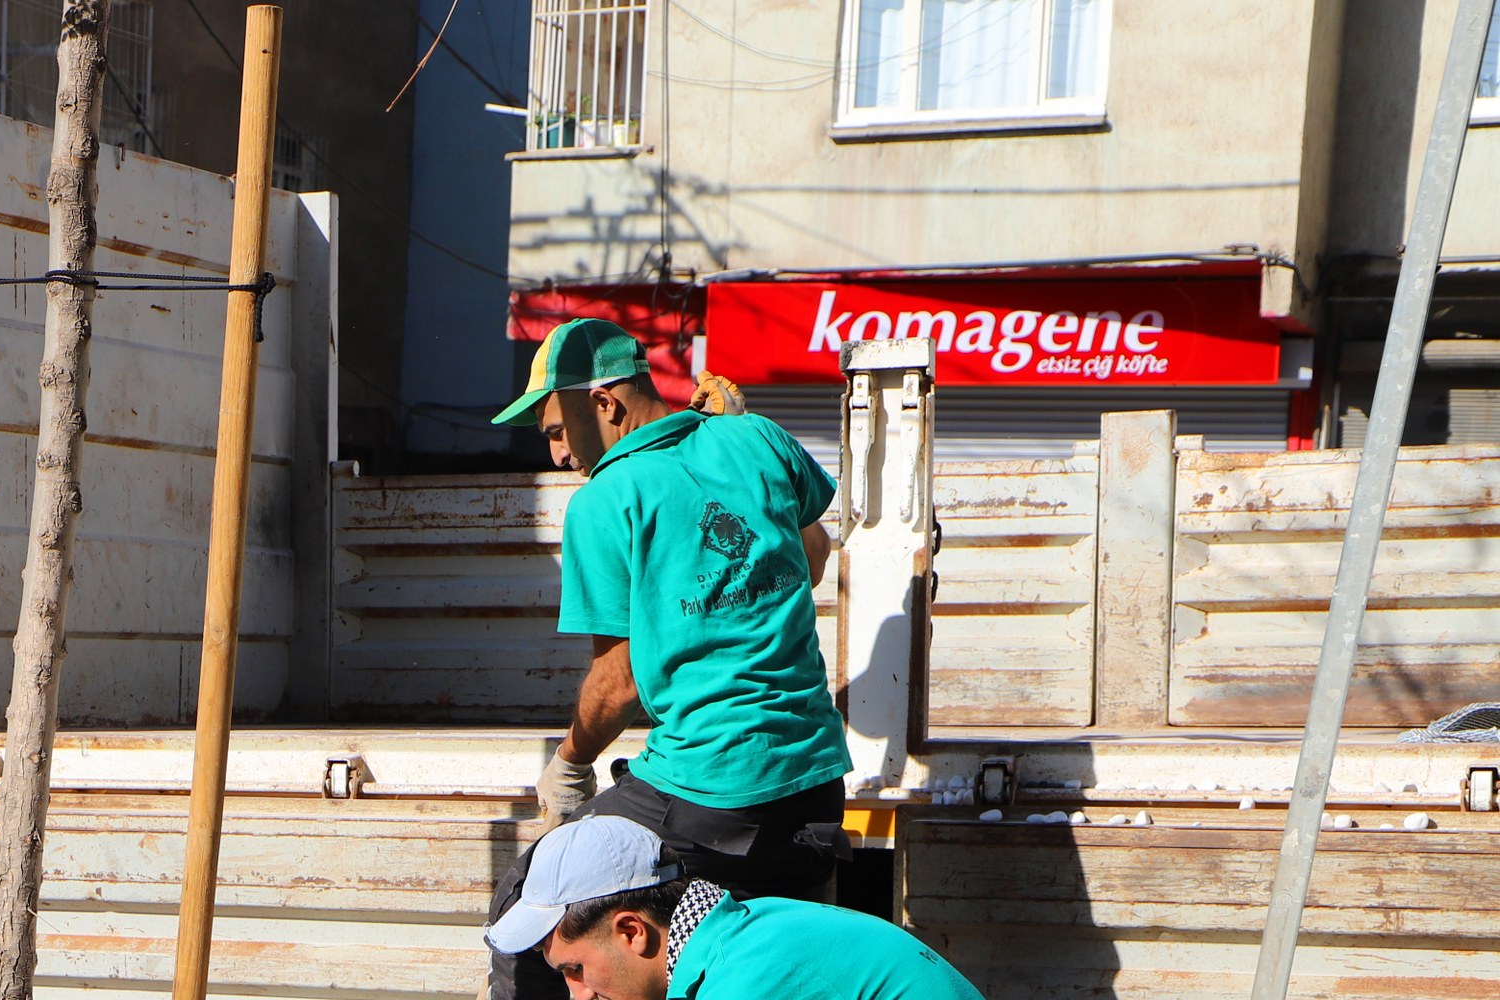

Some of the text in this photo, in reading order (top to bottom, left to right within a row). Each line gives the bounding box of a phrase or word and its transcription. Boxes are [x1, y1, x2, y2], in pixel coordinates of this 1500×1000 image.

[808, 290, 1165, 372] komagene
[1036, 354, 1169, 379] etsiz çiğ köfte
[680, 597, 703, 617] Park
